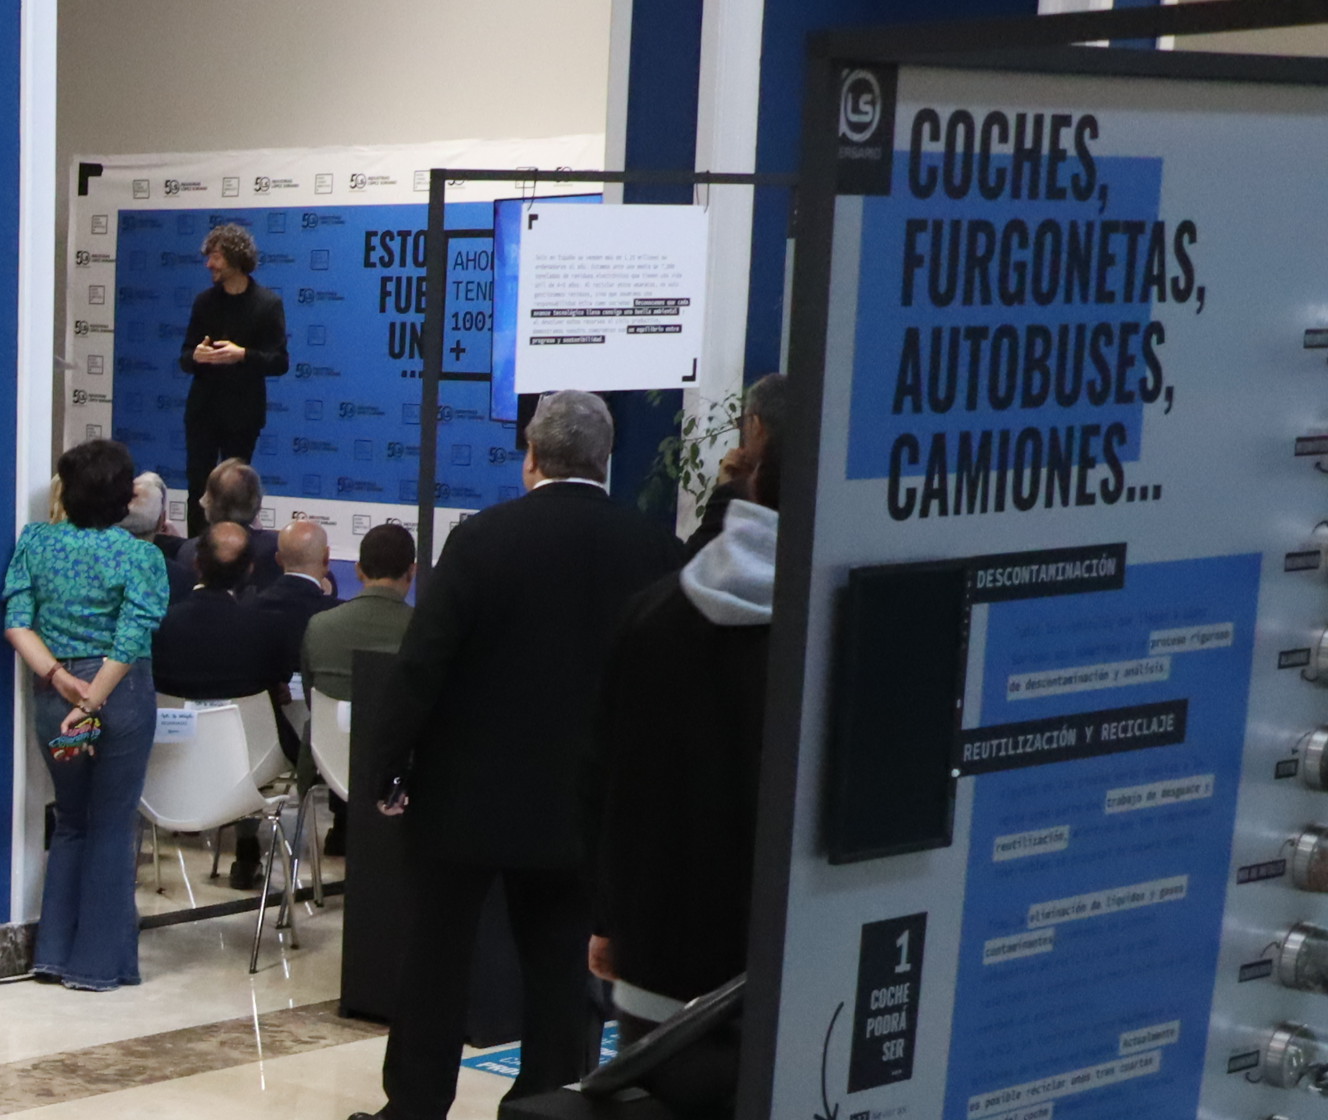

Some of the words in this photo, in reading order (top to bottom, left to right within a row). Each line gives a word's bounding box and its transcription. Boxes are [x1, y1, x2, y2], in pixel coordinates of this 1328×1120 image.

[846, 92, 877, 124] LS
[909, 107, 1108, 214] COCHES,
[363, 230, 428, 270] ESTO
[900, 217, 1206, 314] FURGONETAS,
[379, 275, 426, 314] FUE
[389, 321, 424, 359] UN
[891, 320, 1174, 415] AUTOBUSES,
[887, 421, 1162, 522] CAMIONES...
[976, 553, 1118, 590] DESCONTAMINACIÓN
[1150, 633, 1186, 651] proceso
[1009, 677, 1022, 692] de
[1025, 667, 1111, 691] descontaminación
[963, 724, 1076, 762] REUTILIZACIÓN
[1084, 726, 1094, 742] Y
[1101, 714, 1175, 741] RECICLAJE
[1107, 791, 1143, 809] trabajo
[1029, 900, 1087, 924] eliminación
[894, 929, 912, 974] 1
[870, 982, 910, 1010] COCHE
[865, 1004, 908, 1040] PODRÁ
[881, 1037, 905, 1062] SER
